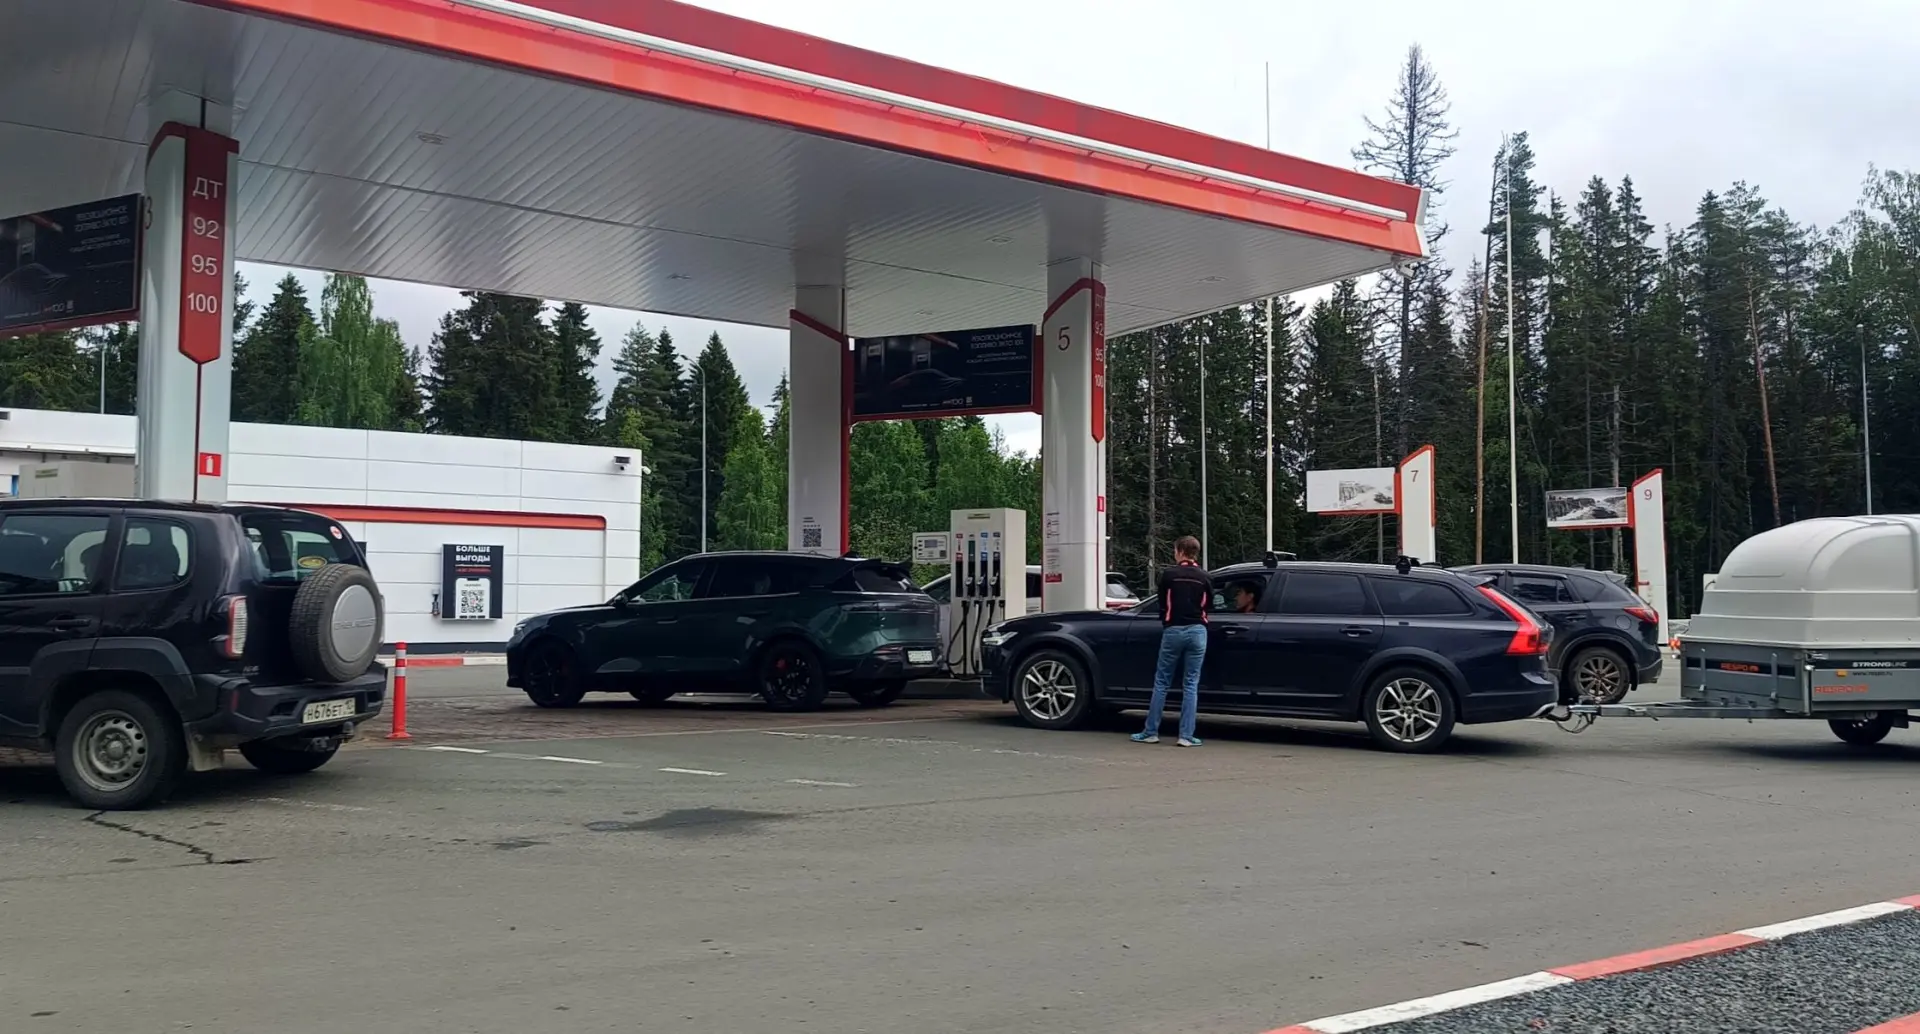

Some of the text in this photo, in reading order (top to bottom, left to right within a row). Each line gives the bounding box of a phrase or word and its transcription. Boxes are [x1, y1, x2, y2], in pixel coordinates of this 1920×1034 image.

[193, 176, 223, 199] ДТ
[193, 216, 219, 240] 92
[191, 254, 218, 276] 95
[187, 292, 218, 314] 100
[1057, 326, 1070, 351] 5
[1410, 470, 1419, 482] 7
[1644, 489, 1652, 500] 9
